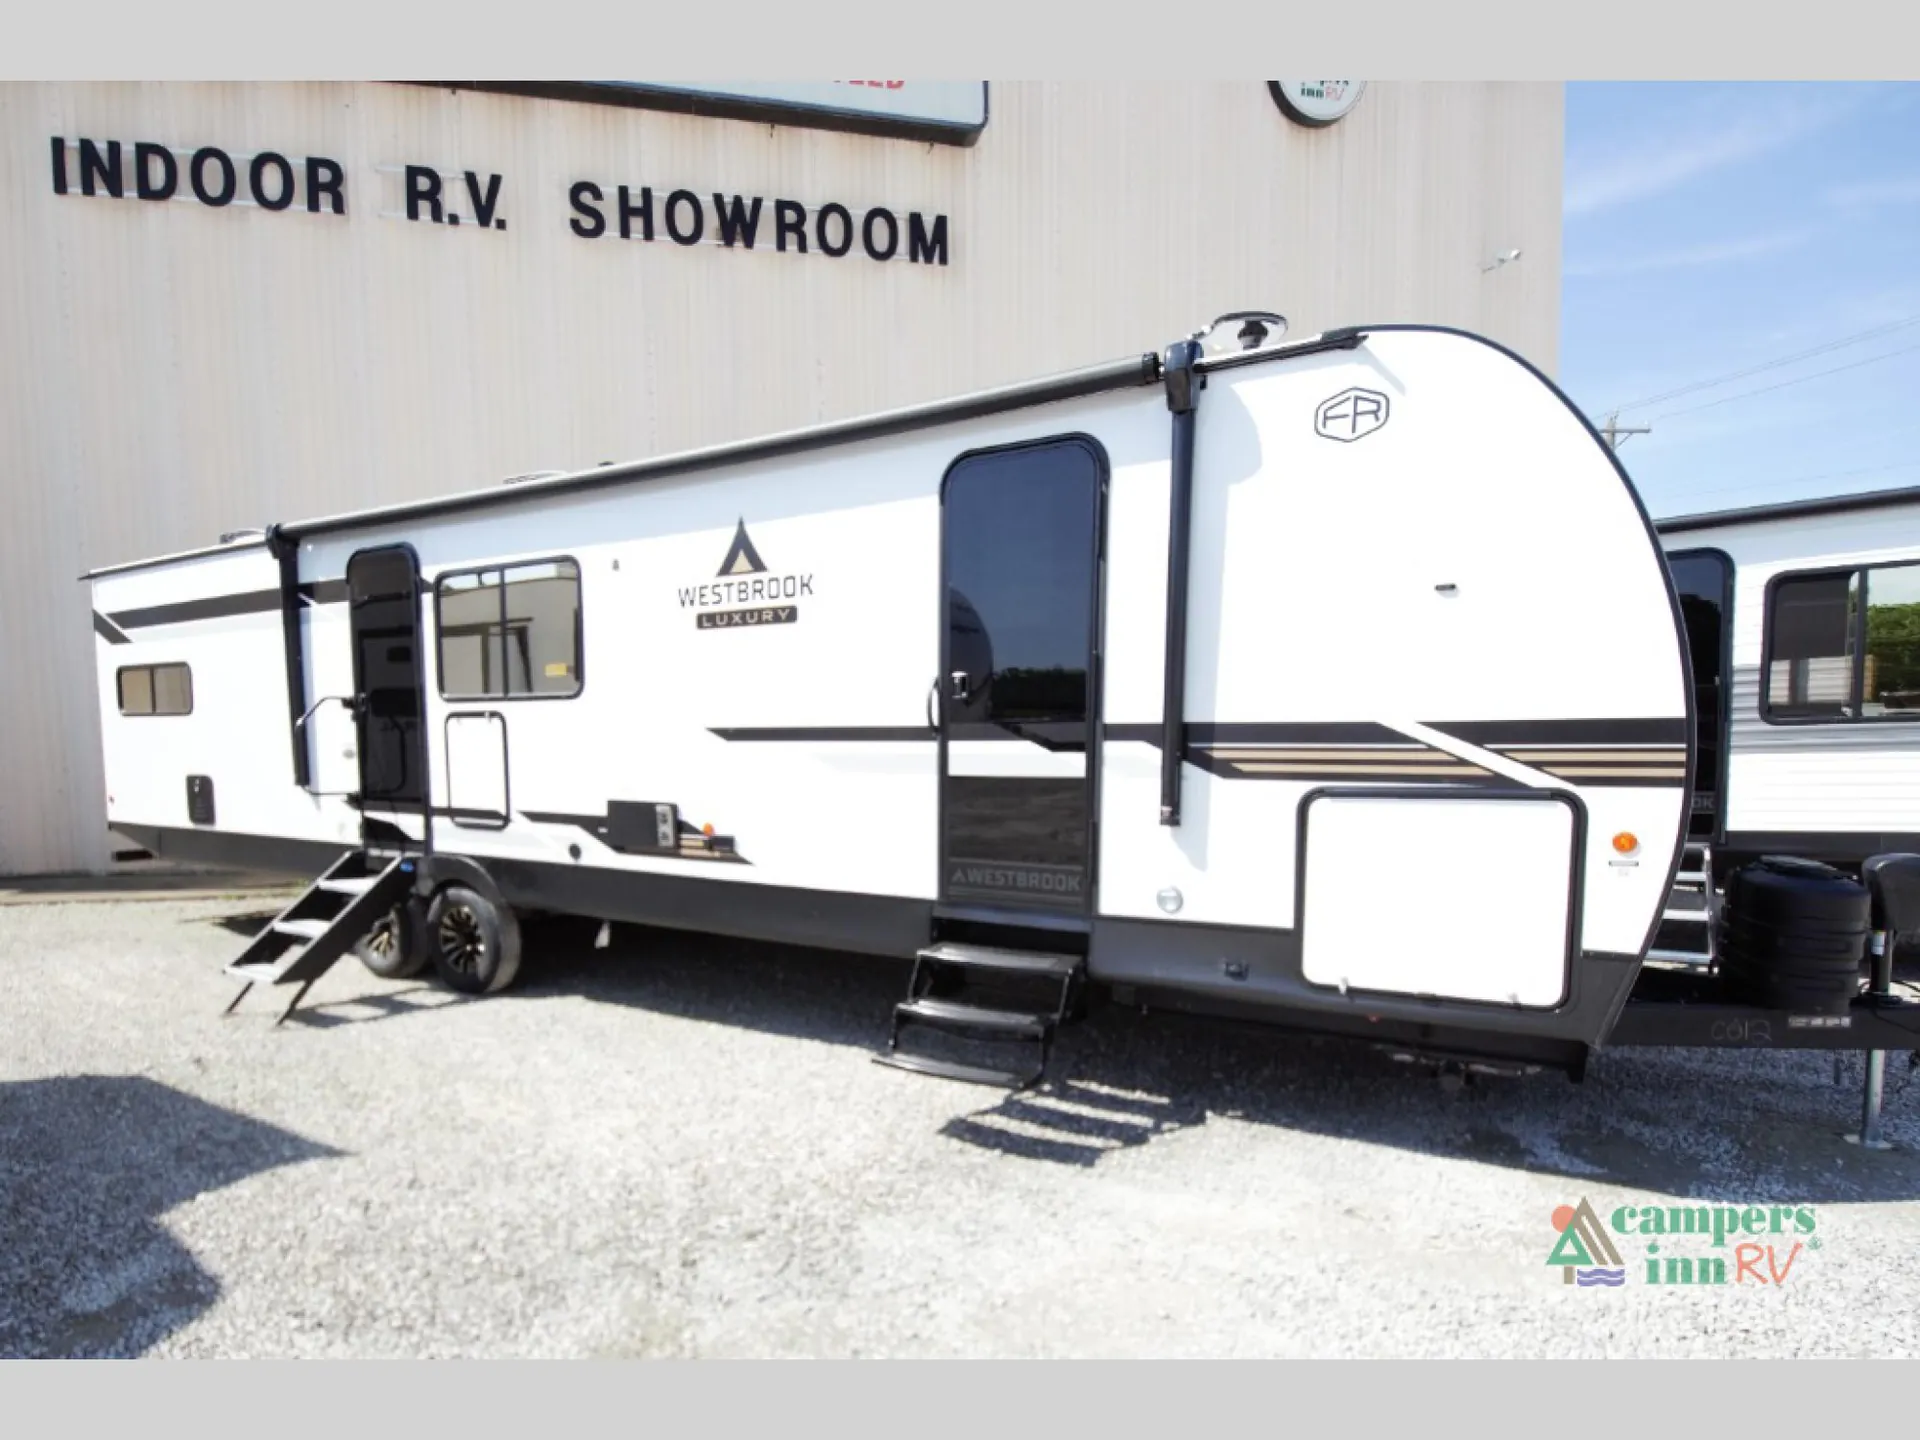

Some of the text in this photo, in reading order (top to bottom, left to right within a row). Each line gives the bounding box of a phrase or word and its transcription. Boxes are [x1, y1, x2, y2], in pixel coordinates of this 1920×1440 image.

[51, 136, 948, 265] INDOOR R.V. SHOWROOM
[678, 574, 813, 608] WESTBROOK
[702, 608, 790, 627] LUXURY
[967, 868, 1081, 891] WESTBROOK
